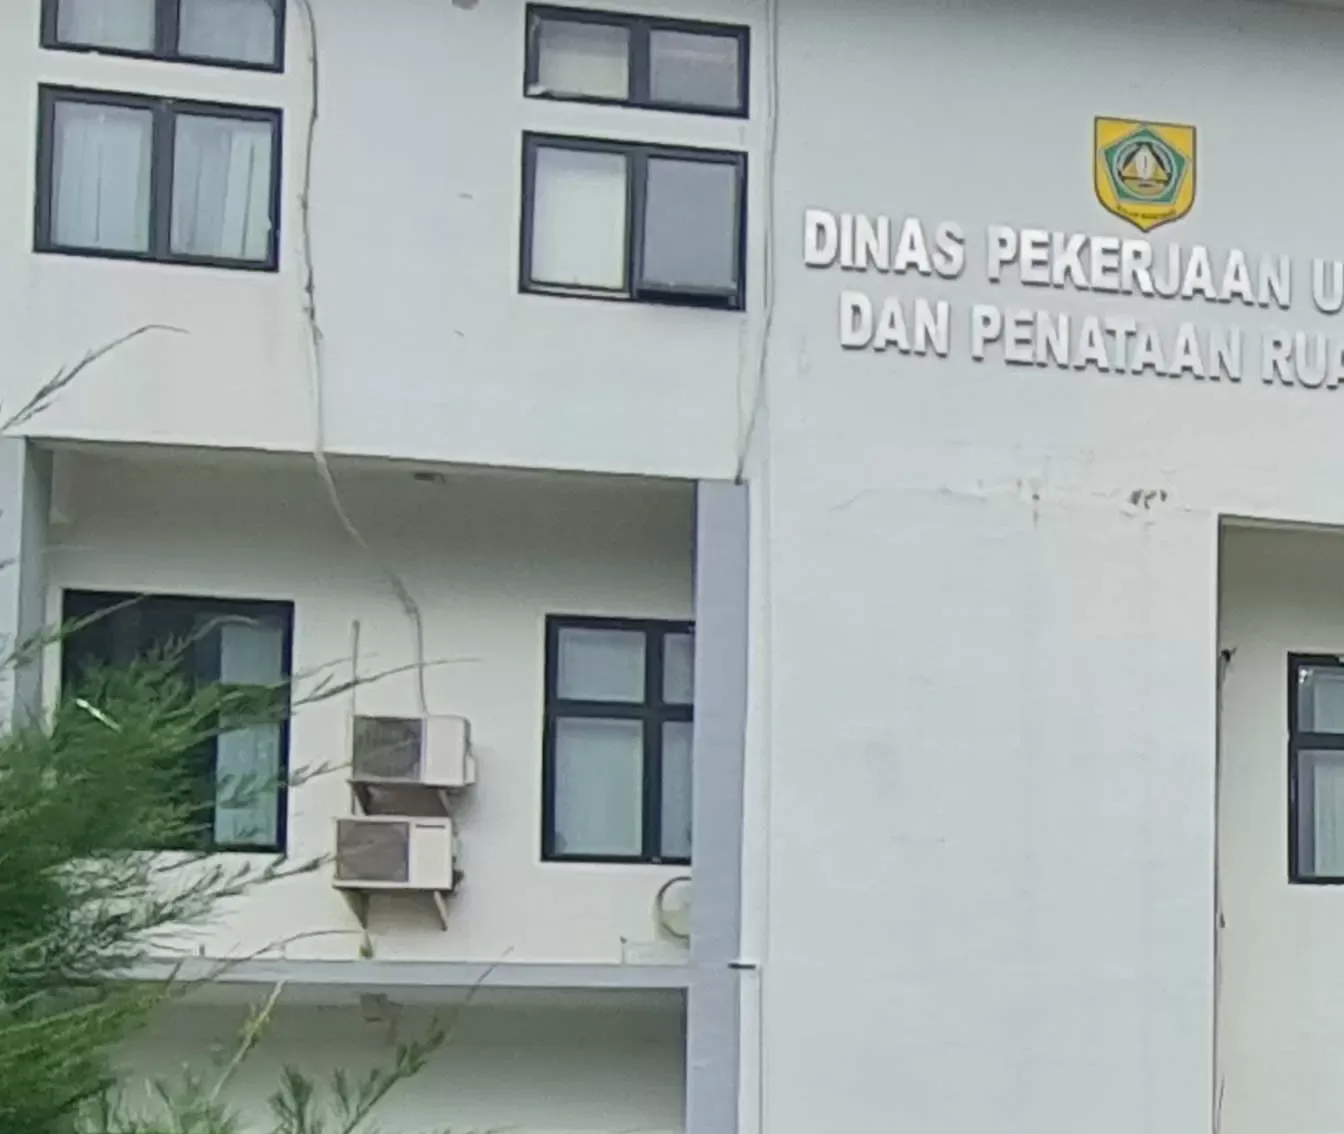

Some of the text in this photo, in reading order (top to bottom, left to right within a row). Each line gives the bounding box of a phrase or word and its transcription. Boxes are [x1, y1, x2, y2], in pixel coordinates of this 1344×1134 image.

[804, 209, 966, 279] DINAS
[987, 226, 1291, 310] PEKERJAAN
[840, 292, 949, 357] DAN
[971, 304, 1242, 382] PENATAAN
